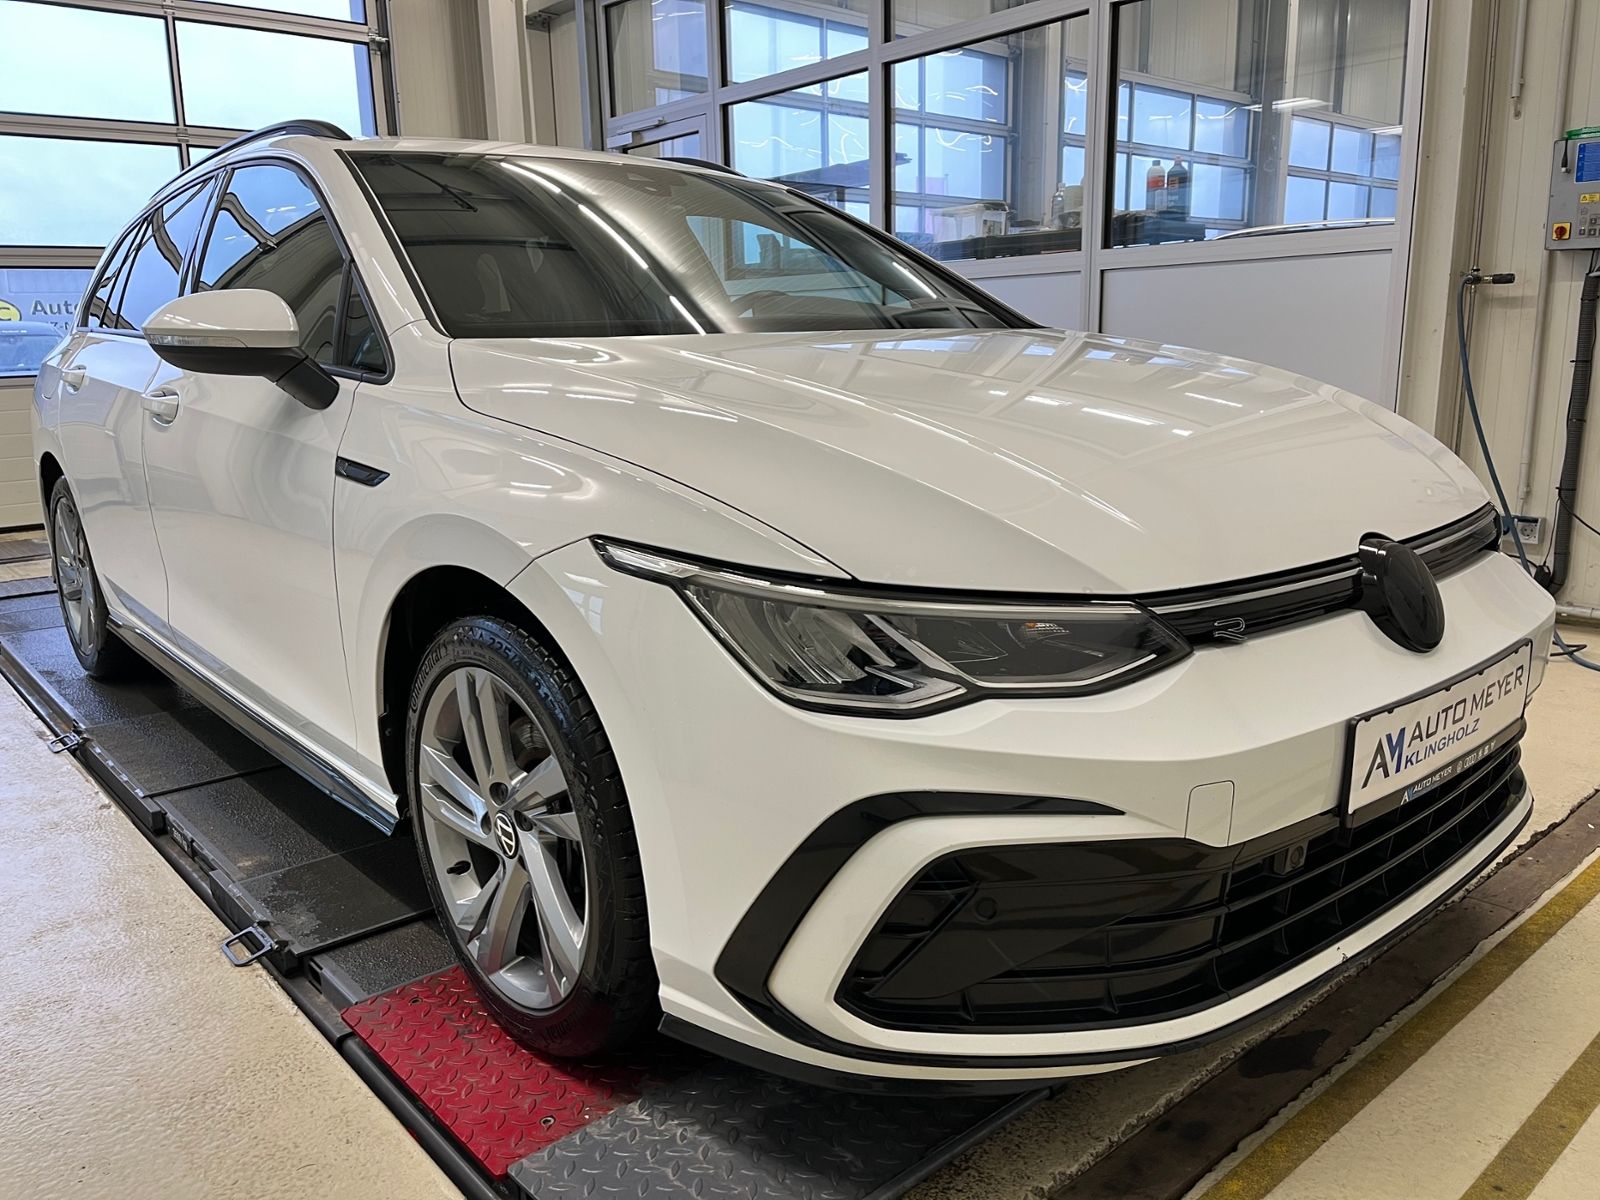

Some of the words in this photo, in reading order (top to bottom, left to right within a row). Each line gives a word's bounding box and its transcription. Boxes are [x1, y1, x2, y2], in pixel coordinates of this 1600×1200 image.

[1408, 697, 1467, 747] AUTO
[1470, 664, 1524, 716] MEYER
[1404, 718, 1479, 769] KLINGHOLZ
[1413, 777, 1432, 793] AUTO
[1432, 766, 1453, 784] MEYER
